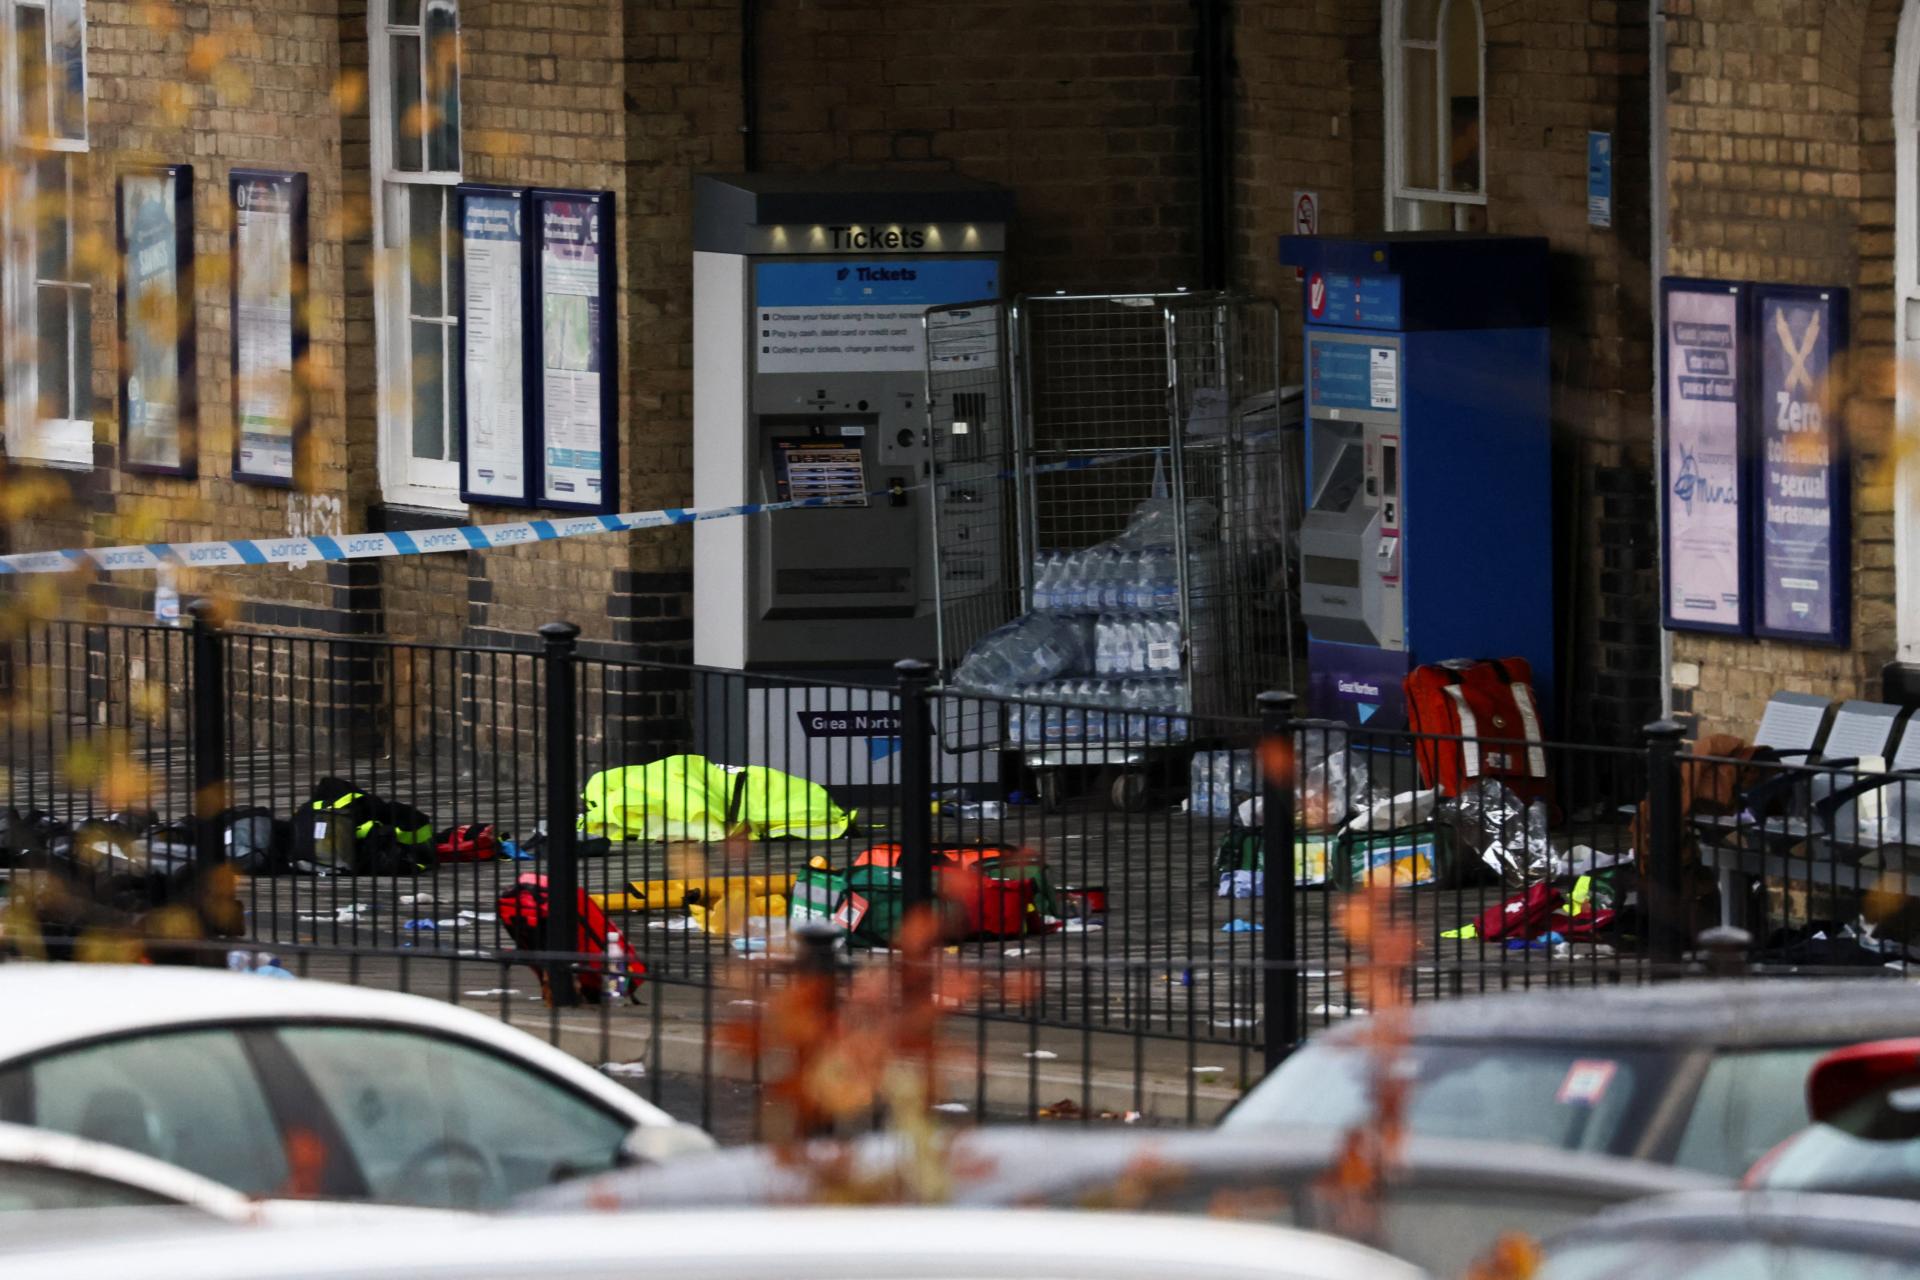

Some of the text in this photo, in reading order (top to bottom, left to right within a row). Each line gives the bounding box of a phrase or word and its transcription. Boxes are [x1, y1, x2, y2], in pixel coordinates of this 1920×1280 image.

[829, 226, 924, 249] Tickets
[856, 267, 917, 282] Tickets
[1777, 391, 1822, 432] Zero
[1780, 470, 1826, 499] sexual
